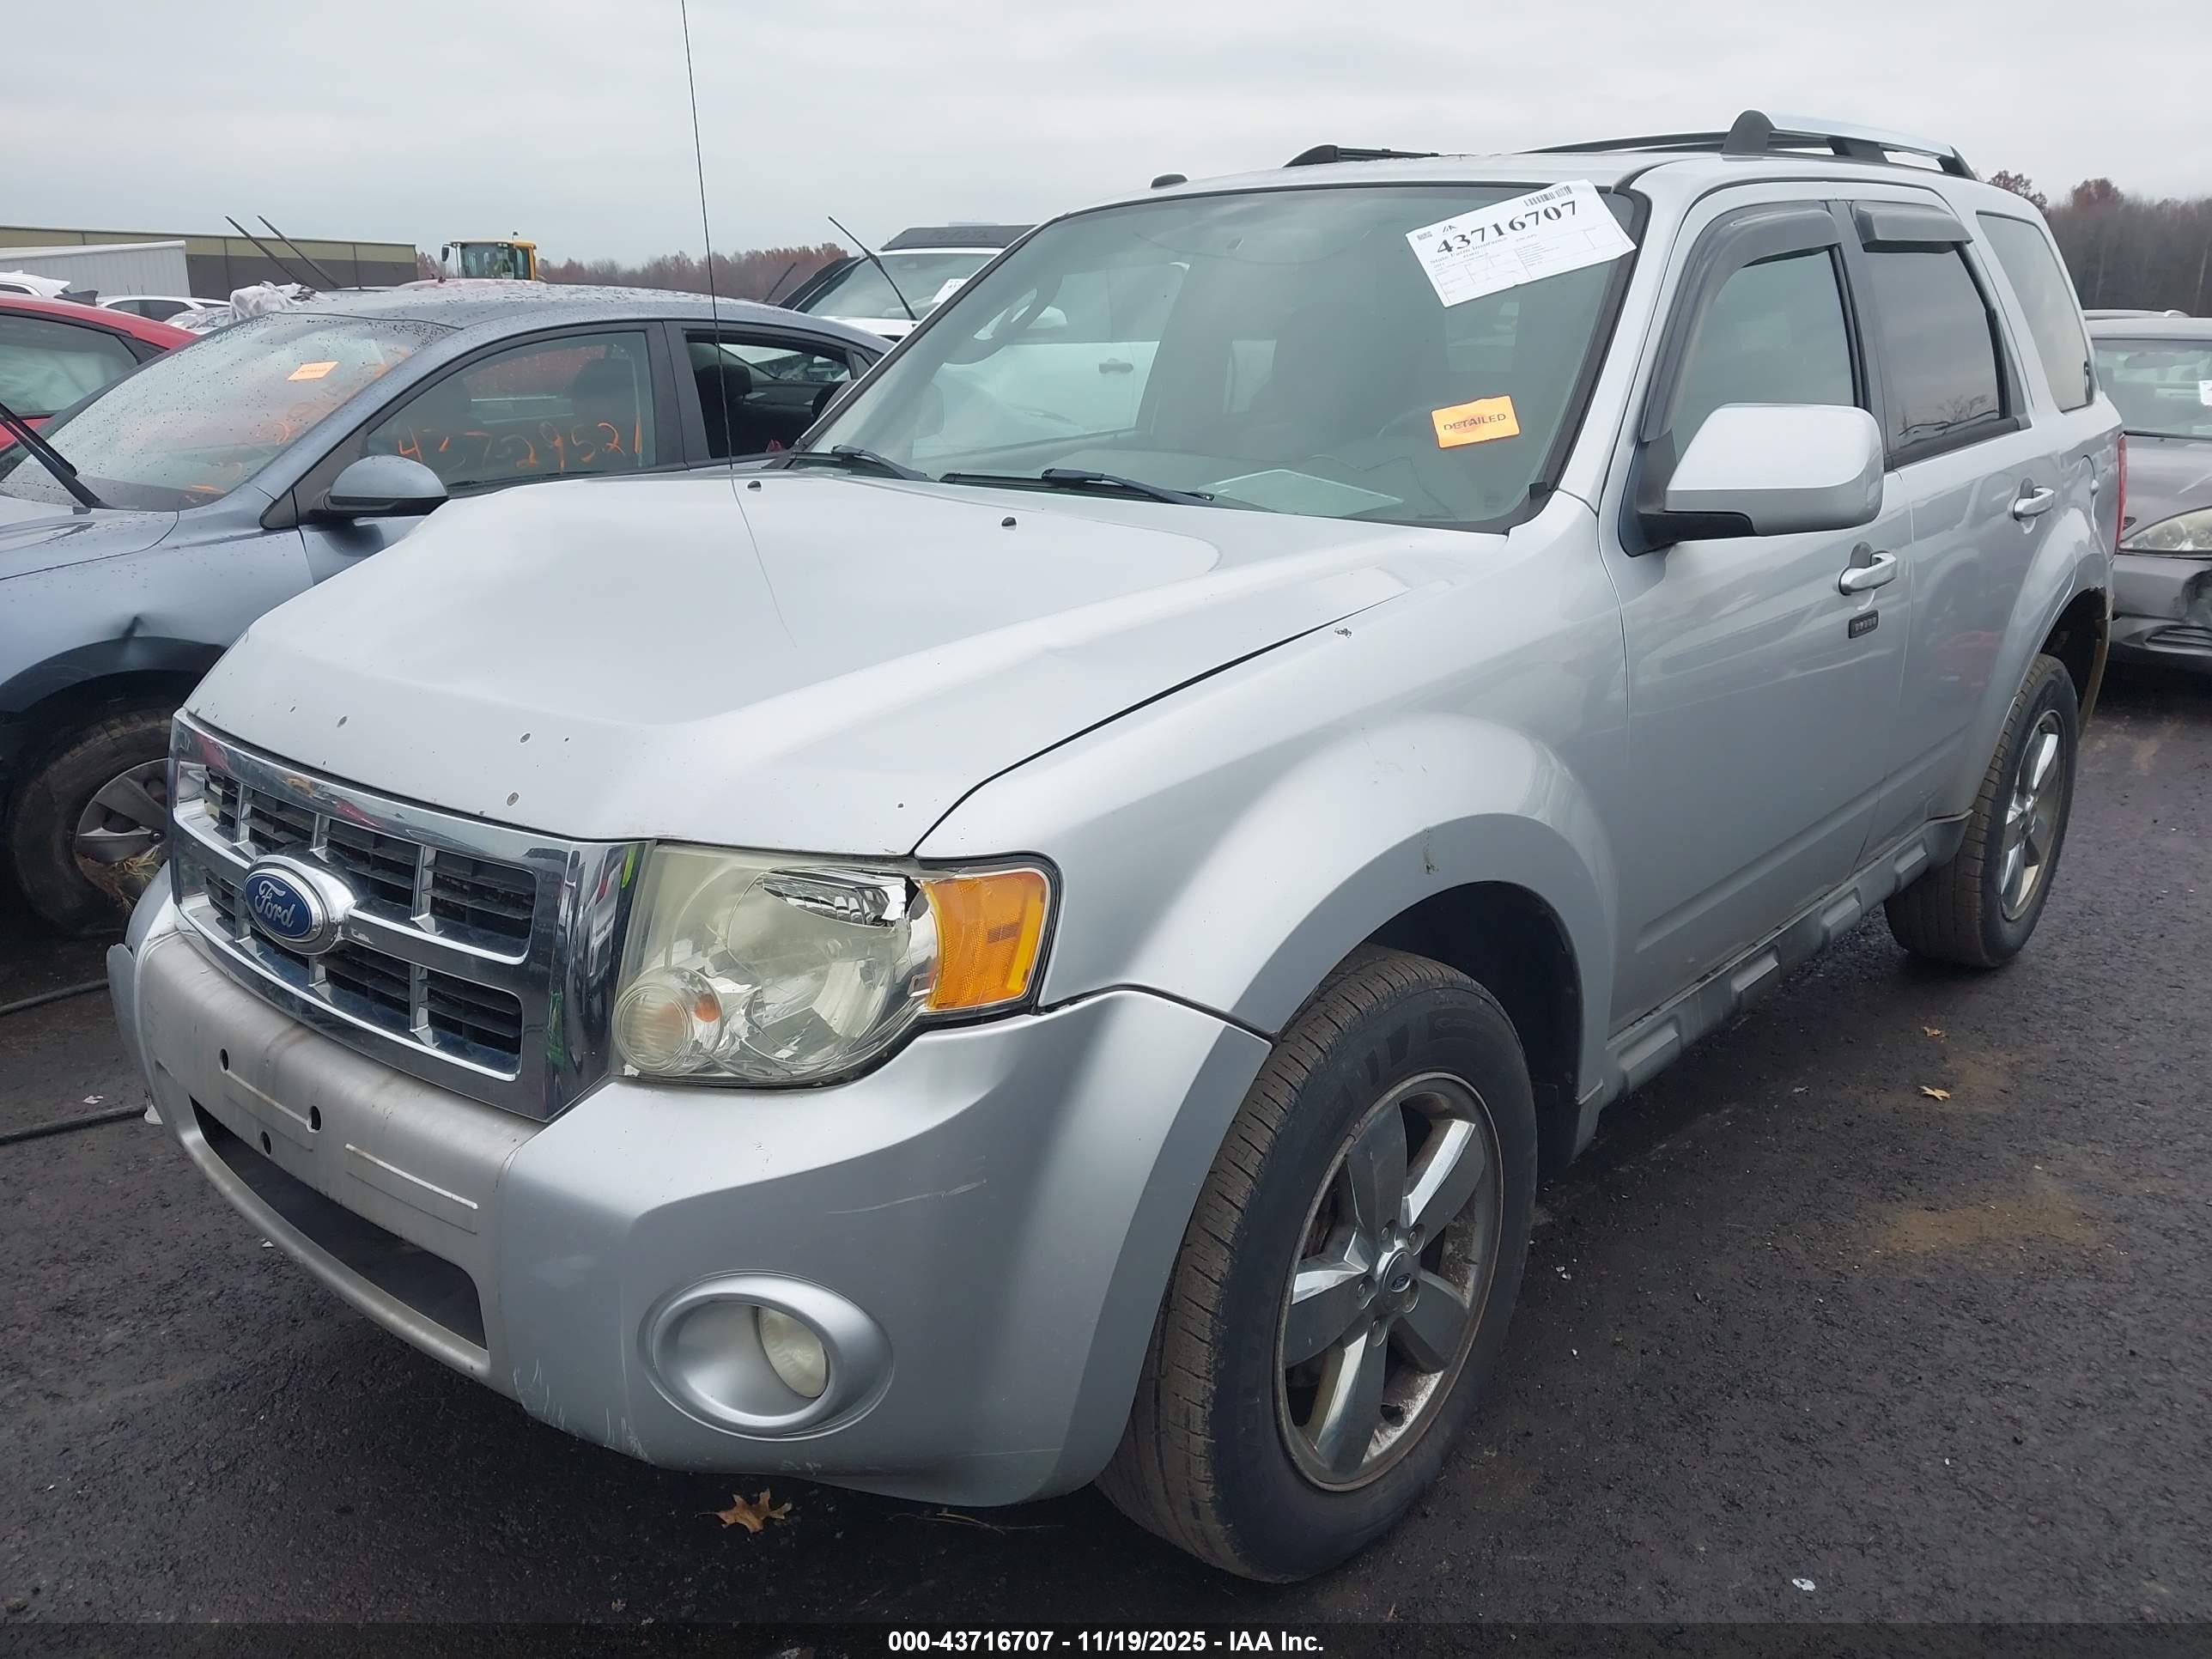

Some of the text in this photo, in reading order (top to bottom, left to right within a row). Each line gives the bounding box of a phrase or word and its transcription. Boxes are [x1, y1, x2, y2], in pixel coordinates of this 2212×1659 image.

[1437, 200, 1577, 253] 43716707
[1443, 413, 1507, 431] DETAILED
[255, 879, 296, 928] Ford
